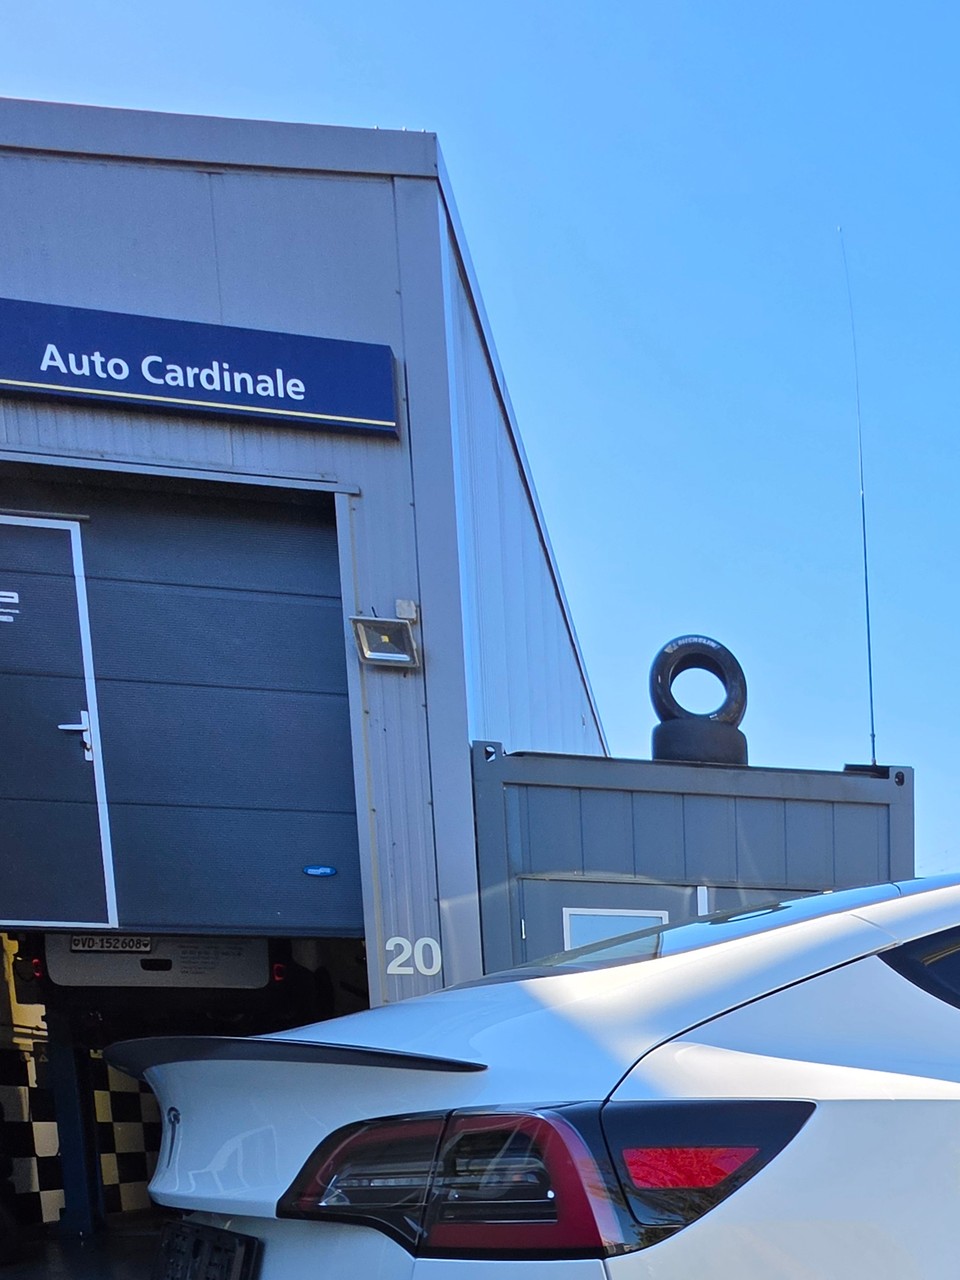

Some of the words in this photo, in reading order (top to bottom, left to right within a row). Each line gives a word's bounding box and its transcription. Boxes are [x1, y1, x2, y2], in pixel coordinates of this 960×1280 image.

[39, 343, 130, 380] Auto
[141, 355, 306, 401] Cardinale
[385, 936, 442, 975] 20
